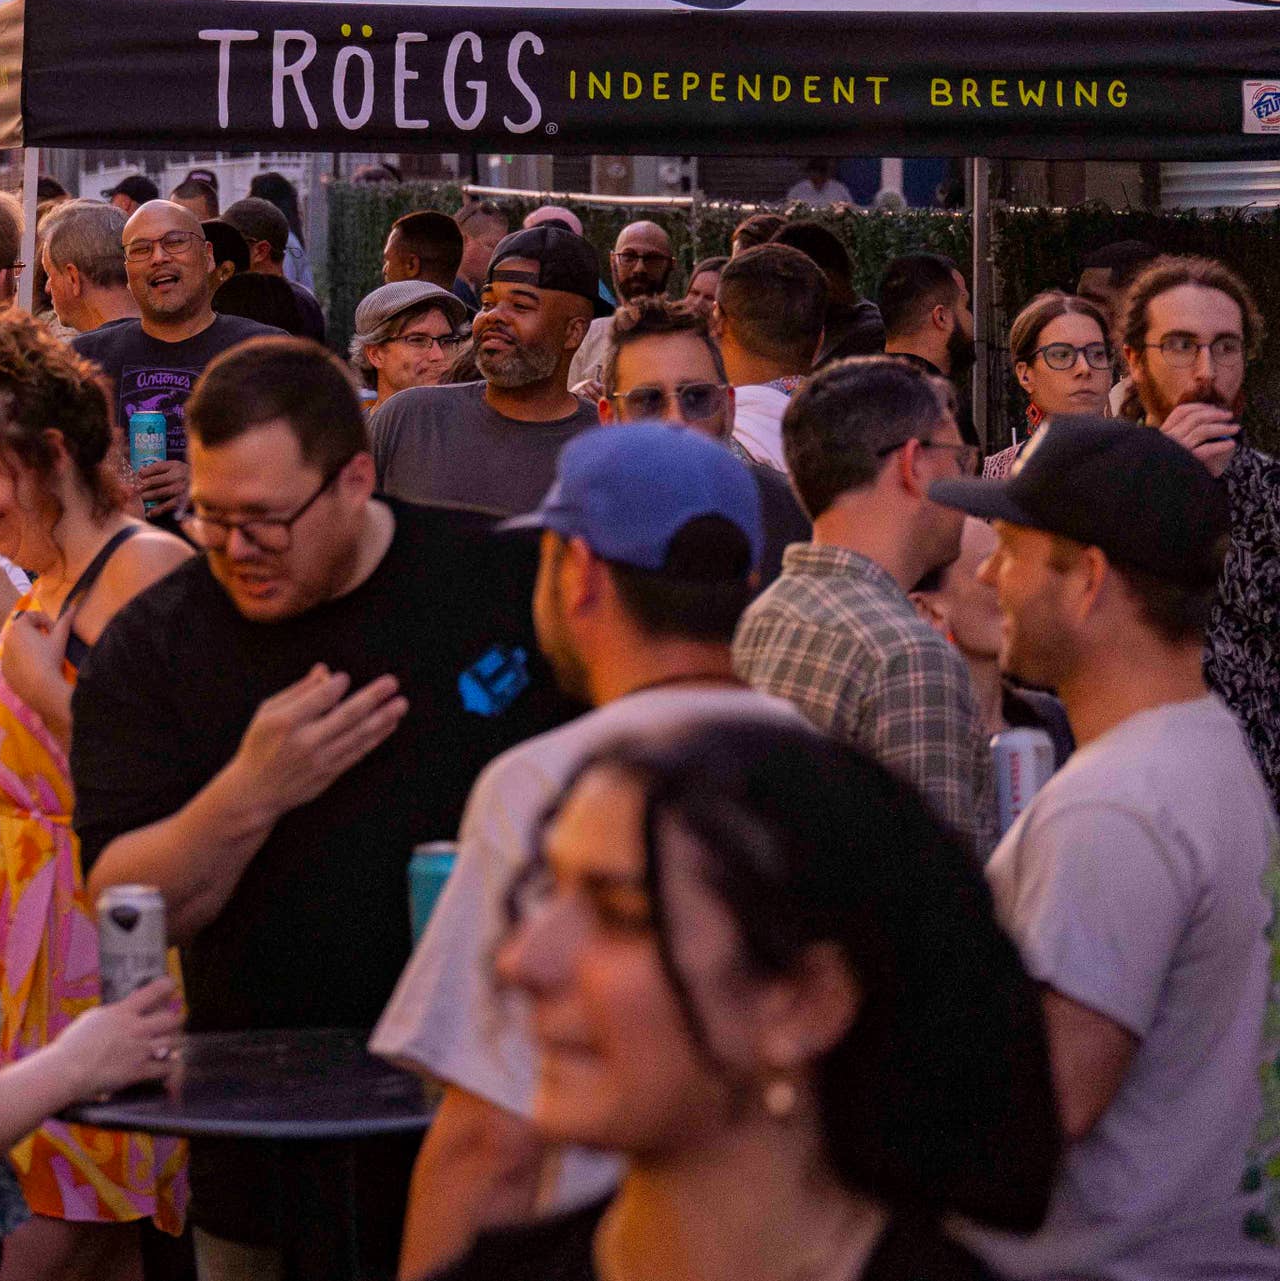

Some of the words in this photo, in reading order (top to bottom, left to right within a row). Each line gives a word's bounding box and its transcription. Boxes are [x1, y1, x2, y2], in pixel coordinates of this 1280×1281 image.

[198, 23, 545, 135] TRÖEGS
[569, 70, 889, 105] INDEPENDENT
[930, 77, 1129, 109] BREWING
